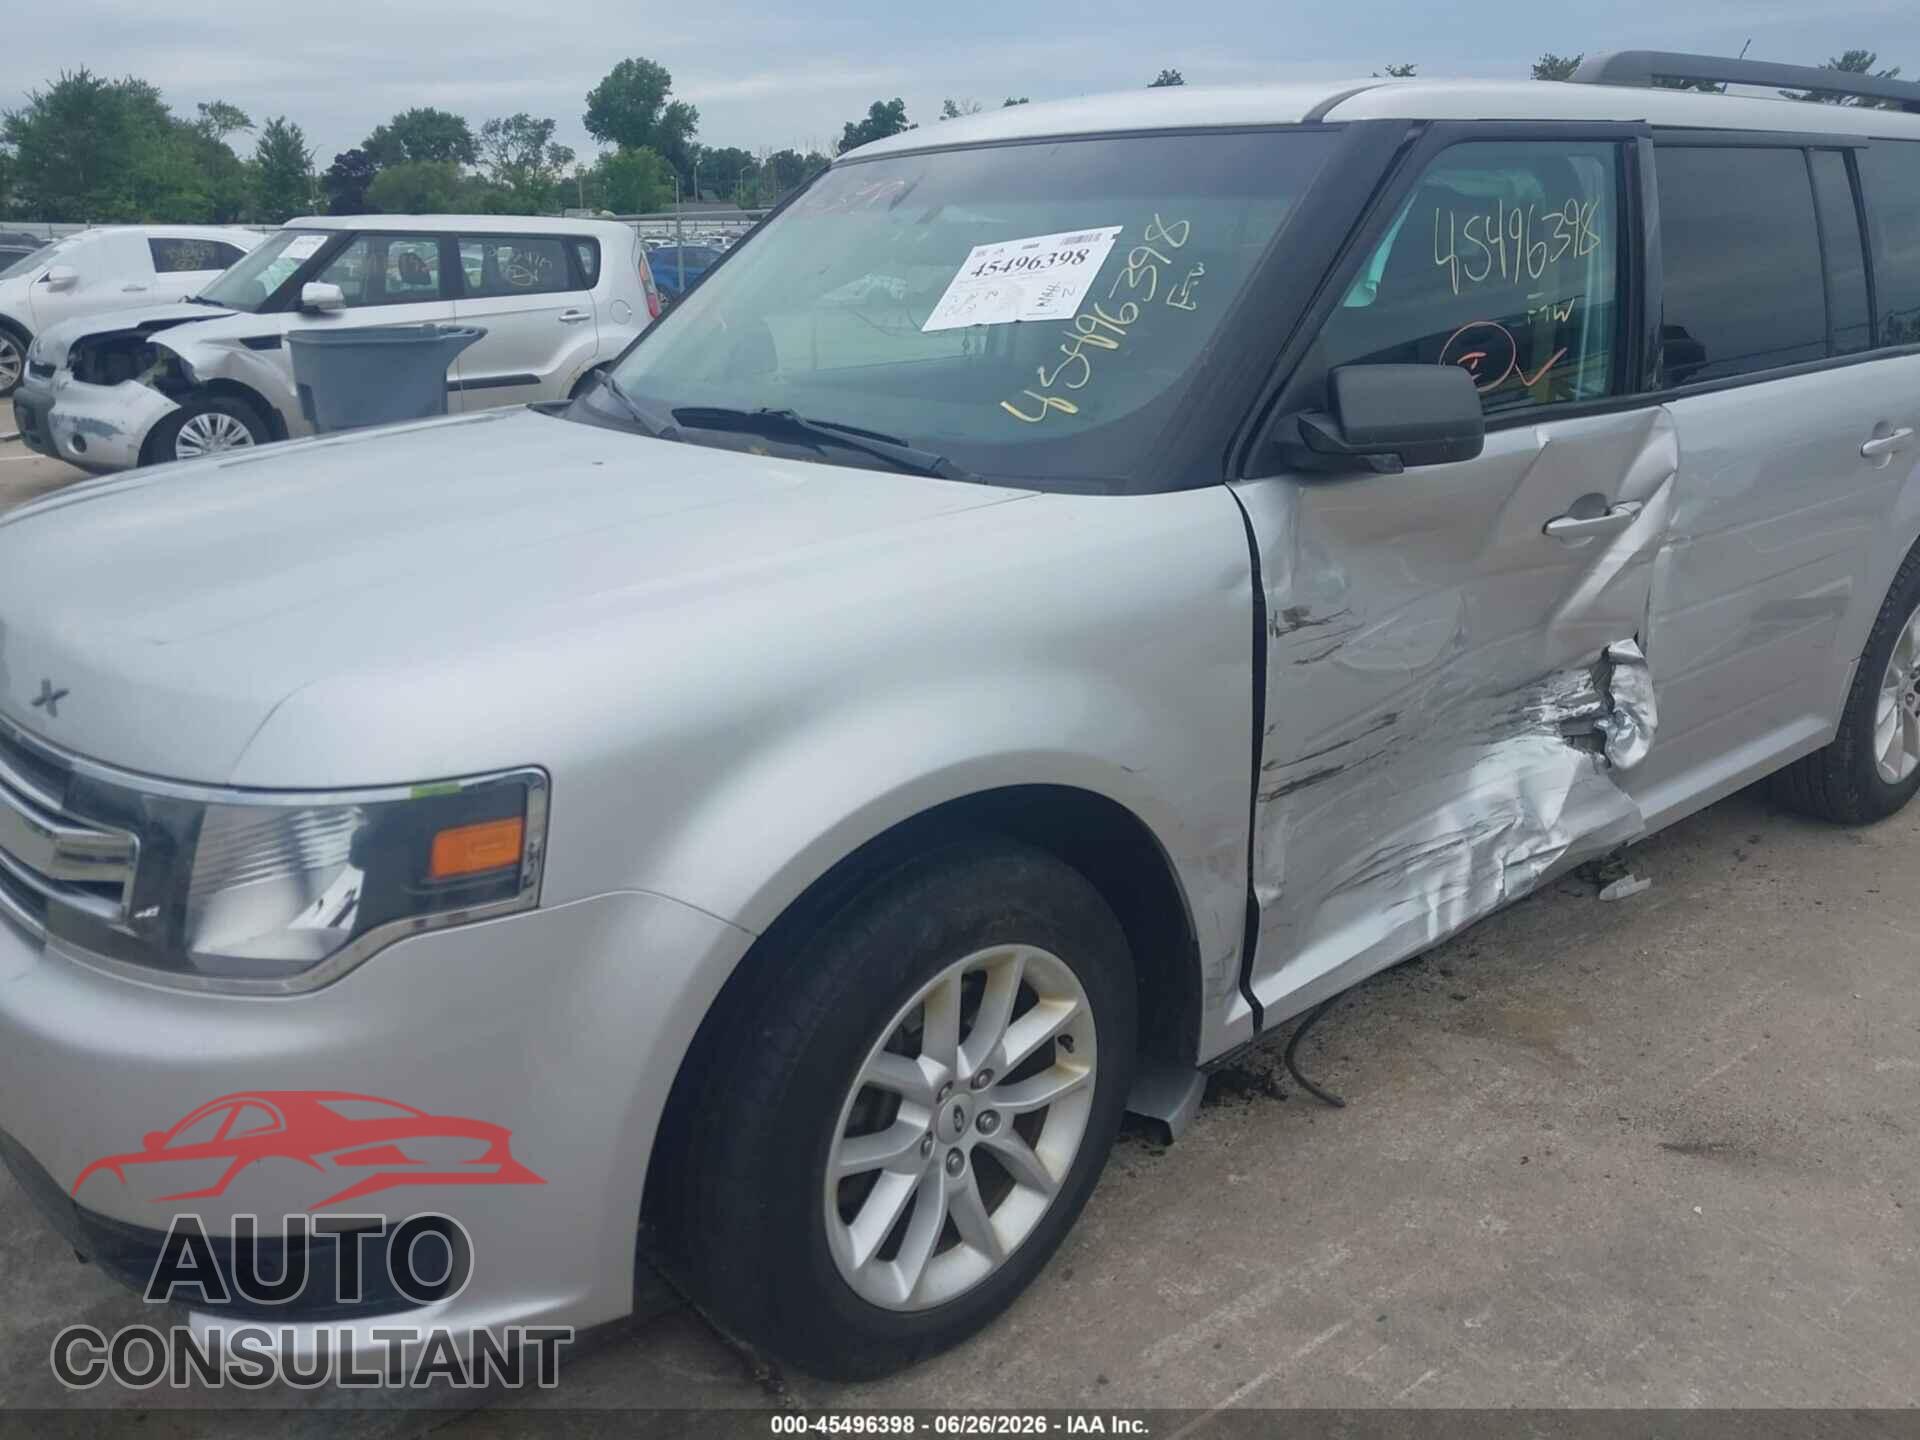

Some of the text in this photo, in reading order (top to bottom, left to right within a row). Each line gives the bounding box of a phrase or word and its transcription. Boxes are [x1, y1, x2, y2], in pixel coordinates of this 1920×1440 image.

[970, 248, 1090, 278] 45496398
[1434, 199, 1600, 295] 45496398
[1000, 213, 1189, 422] 45496398
